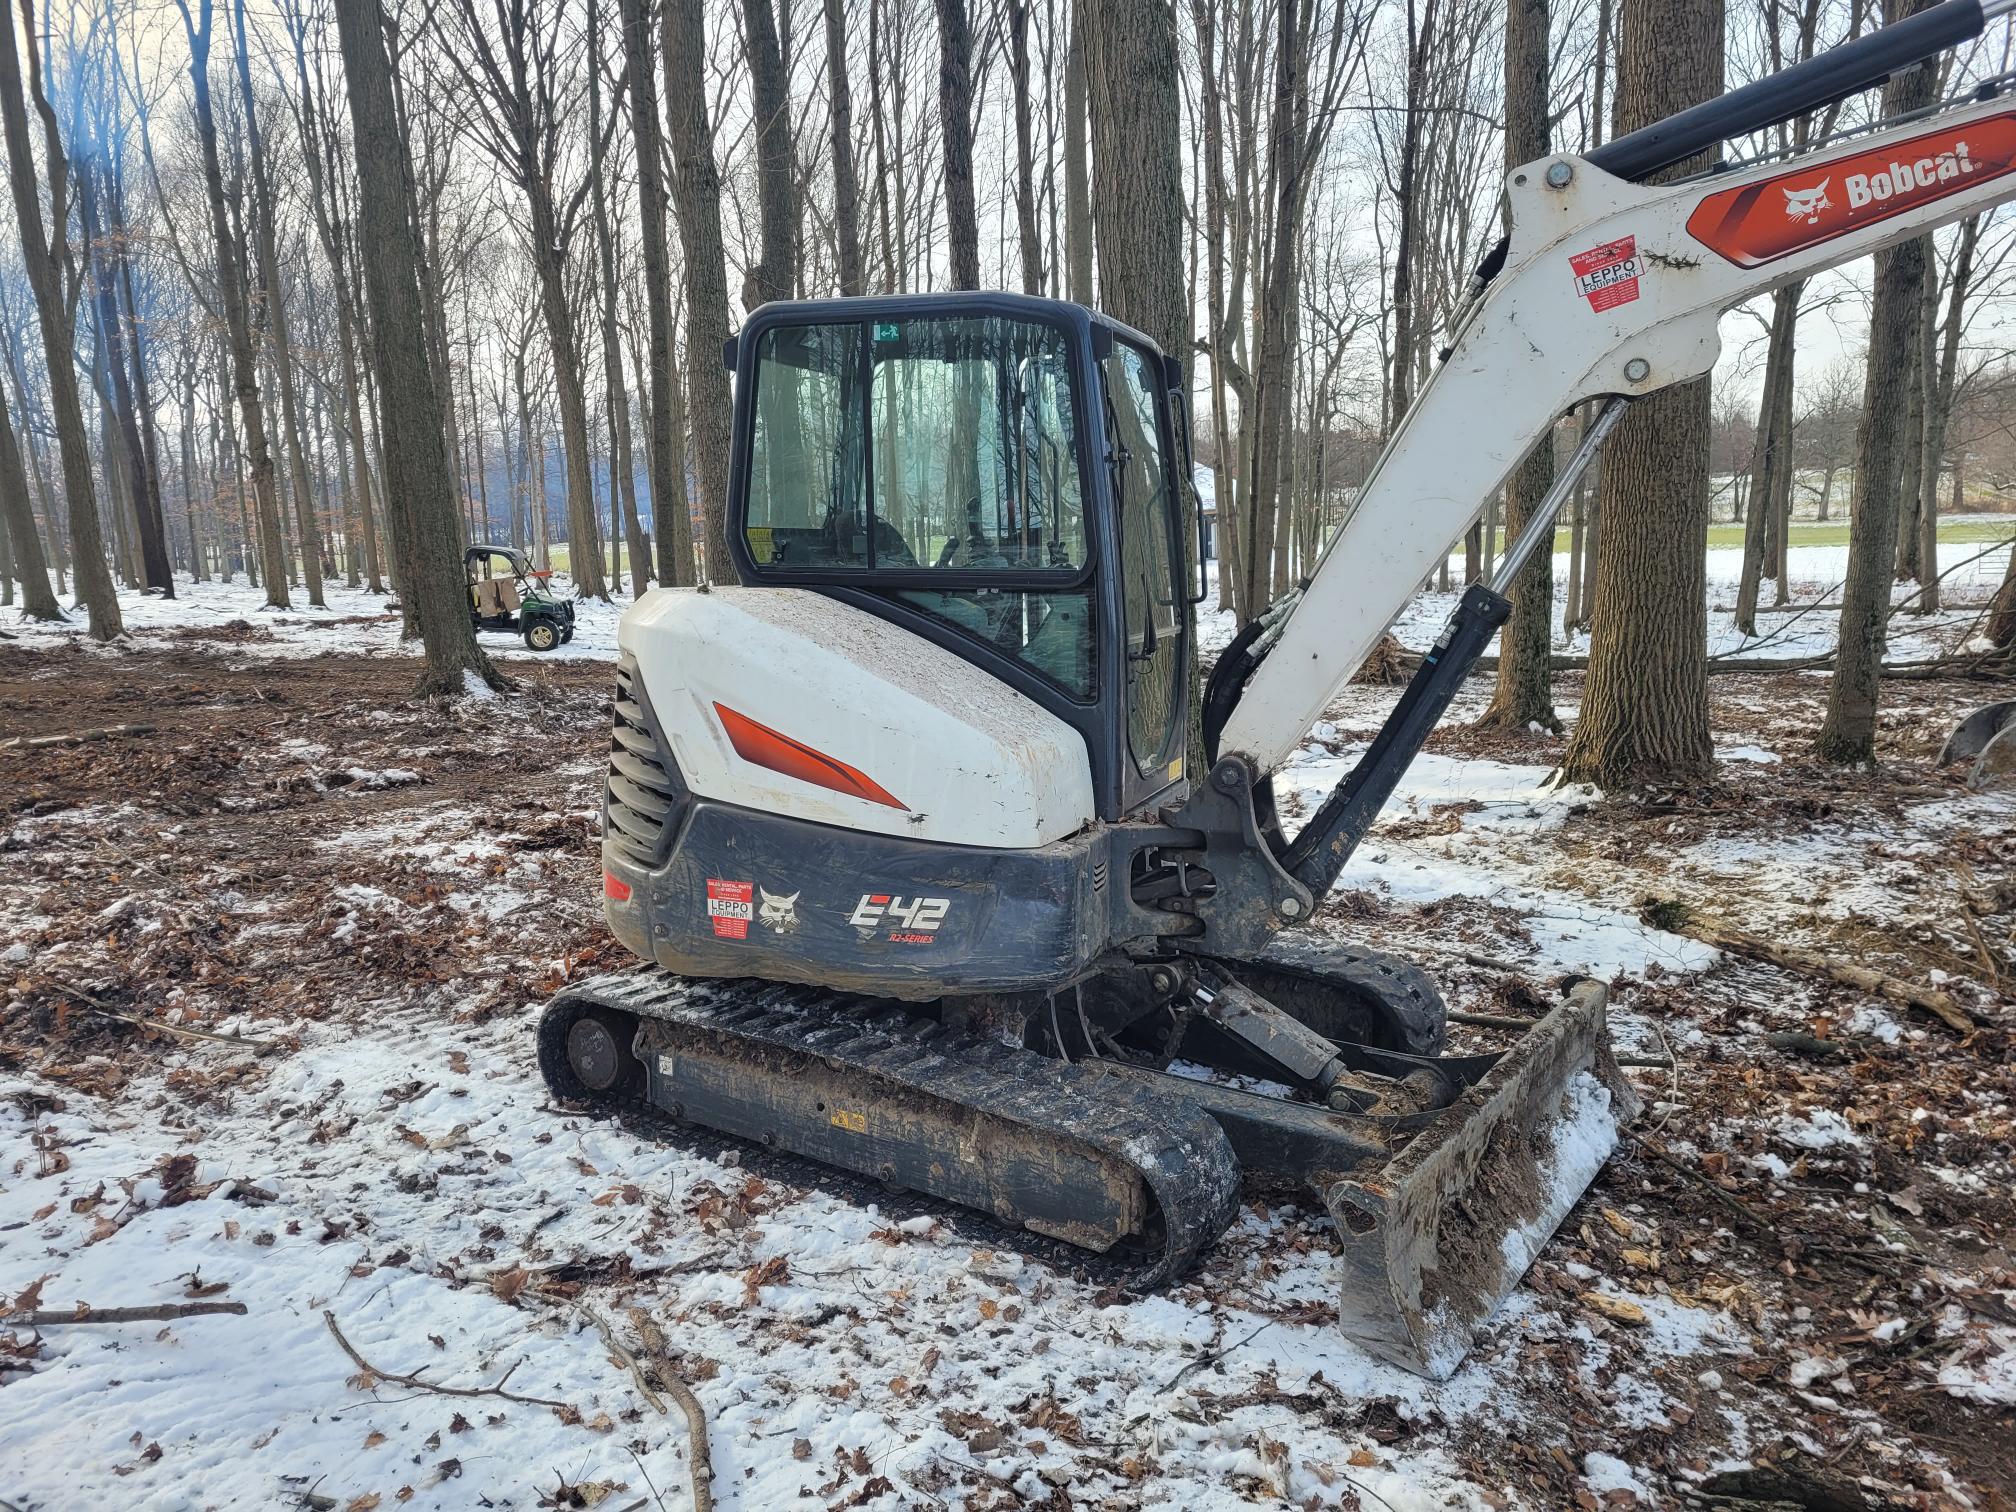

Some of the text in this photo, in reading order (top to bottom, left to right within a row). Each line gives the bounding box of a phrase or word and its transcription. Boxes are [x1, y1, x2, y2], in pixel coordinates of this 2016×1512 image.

[1845, 141, 1973, 209] Bobcat
[1581, 260, 1635, 287] LEPPO
[1583, 270, 1637, 293] EQUIPMENT
[711, 900, 749, 913] LEPPO
[711, 909, 749, 918] EQUIPMENT
[849, 894, 951, 930] E42
[888, 933, 936, 944] R2-SERIES
